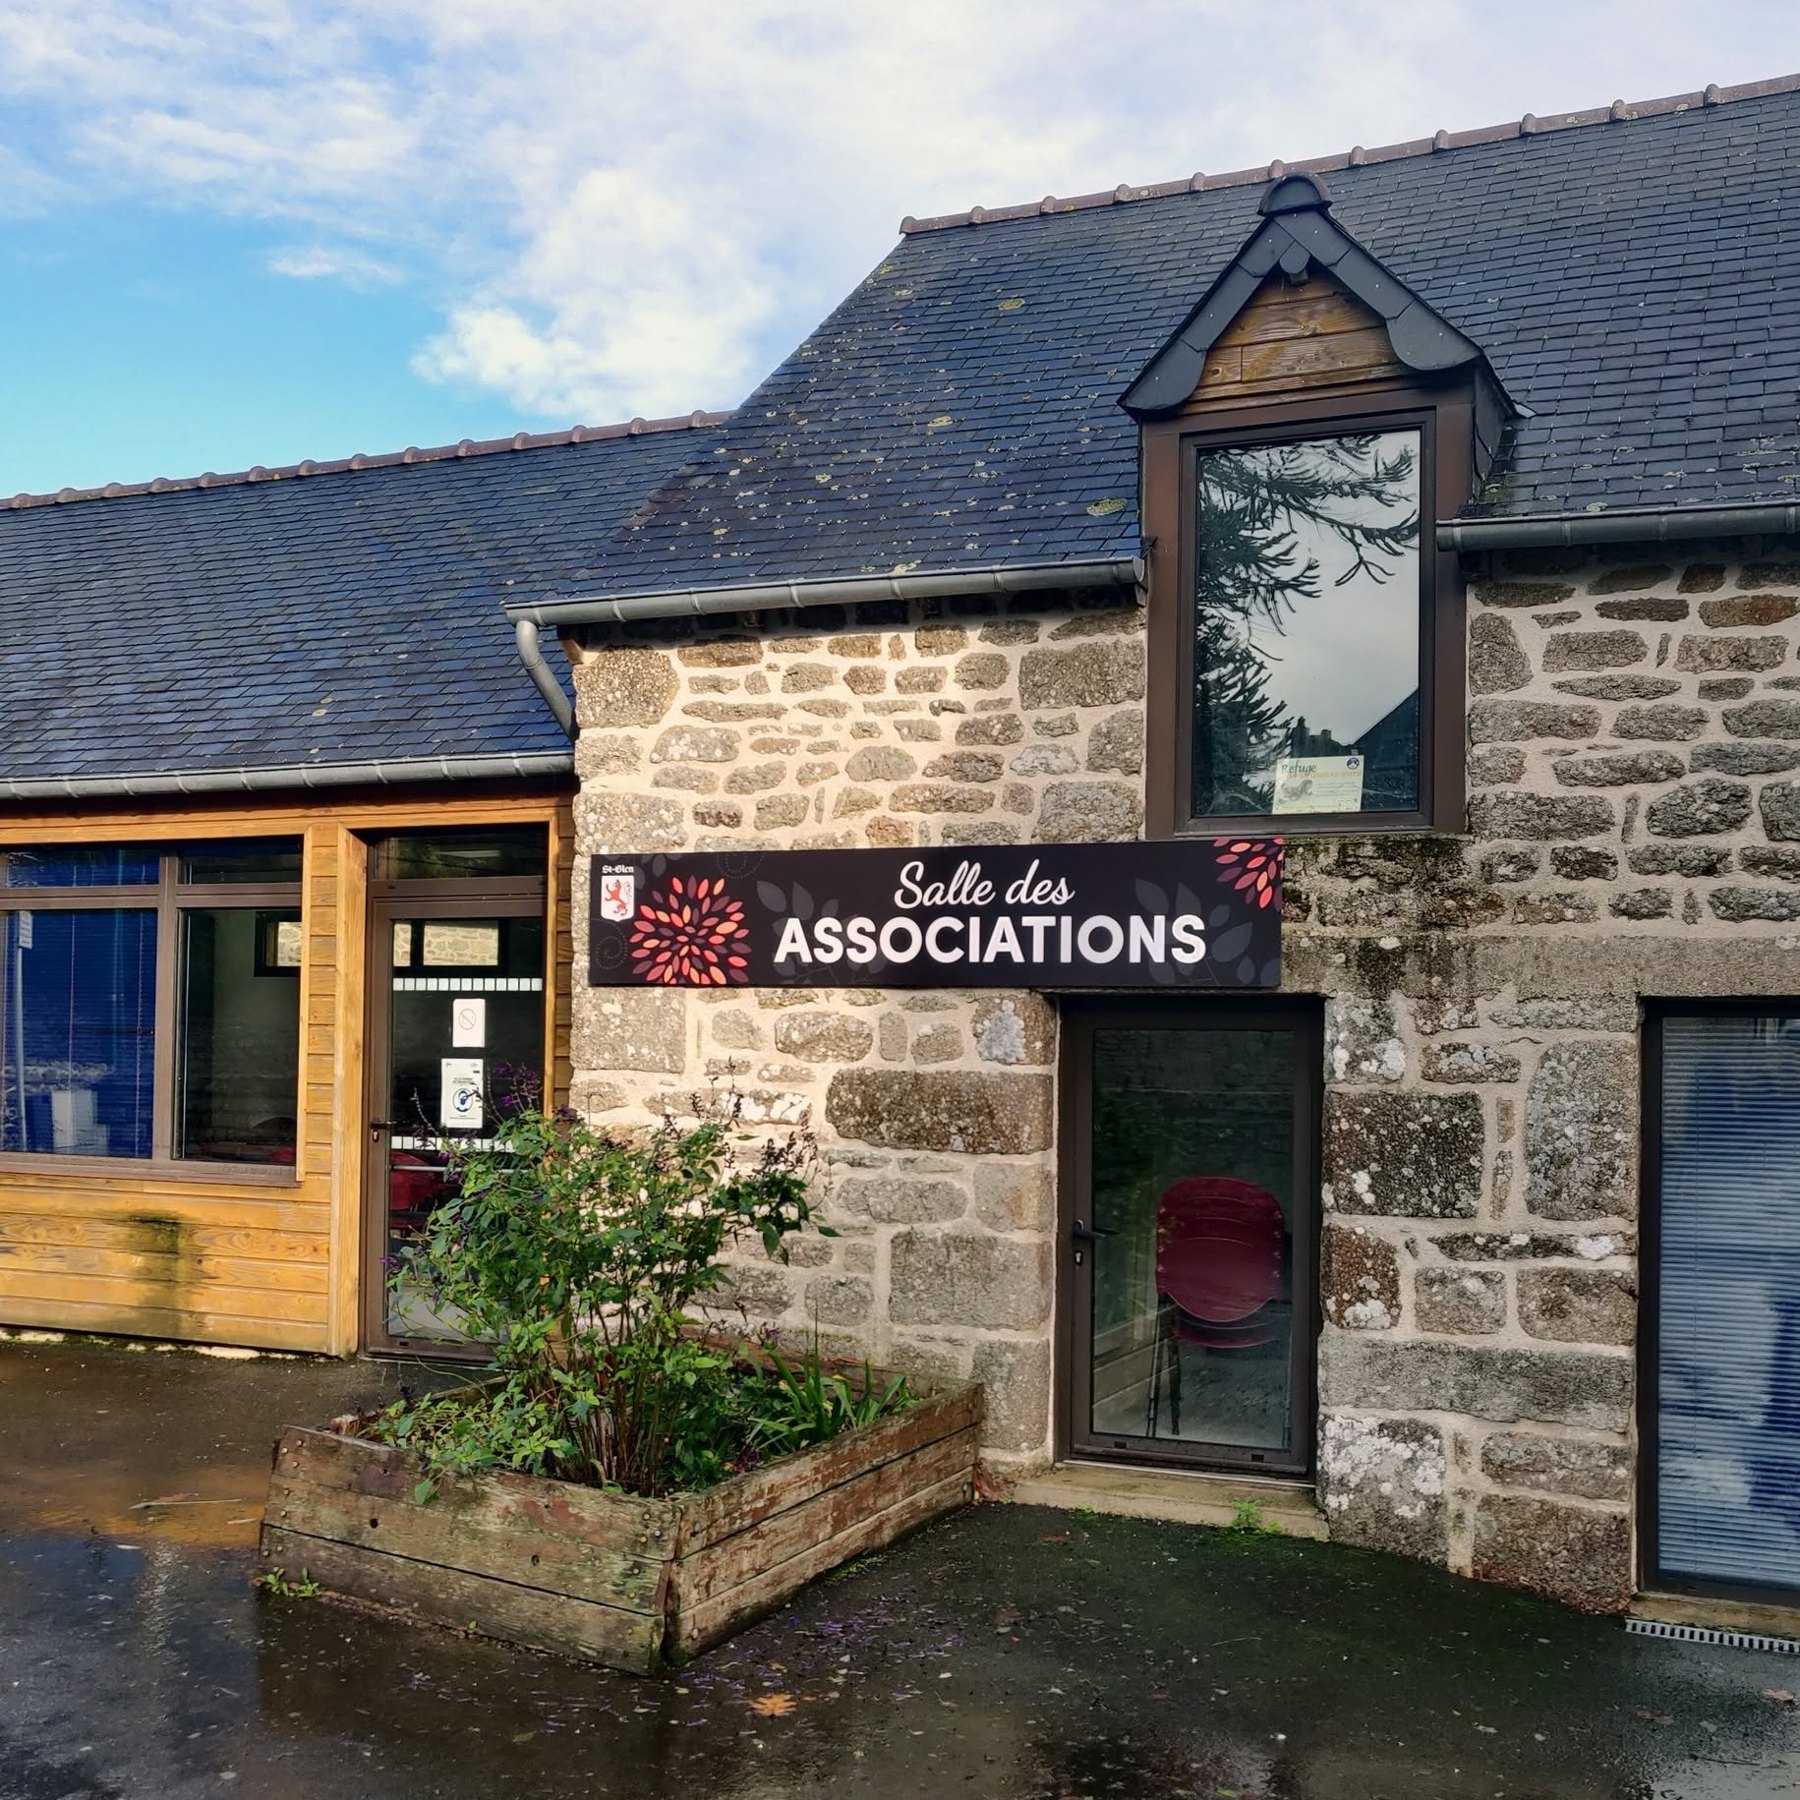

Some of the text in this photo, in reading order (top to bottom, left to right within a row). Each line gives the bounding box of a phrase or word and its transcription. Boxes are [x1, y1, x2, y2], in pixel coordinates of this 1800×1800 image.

[1281, 760, 1317, 776] Refuge
[894, 858, 1075, 909] Salle des
[774, 915, 1207, 964] ASSOCIATIONS
